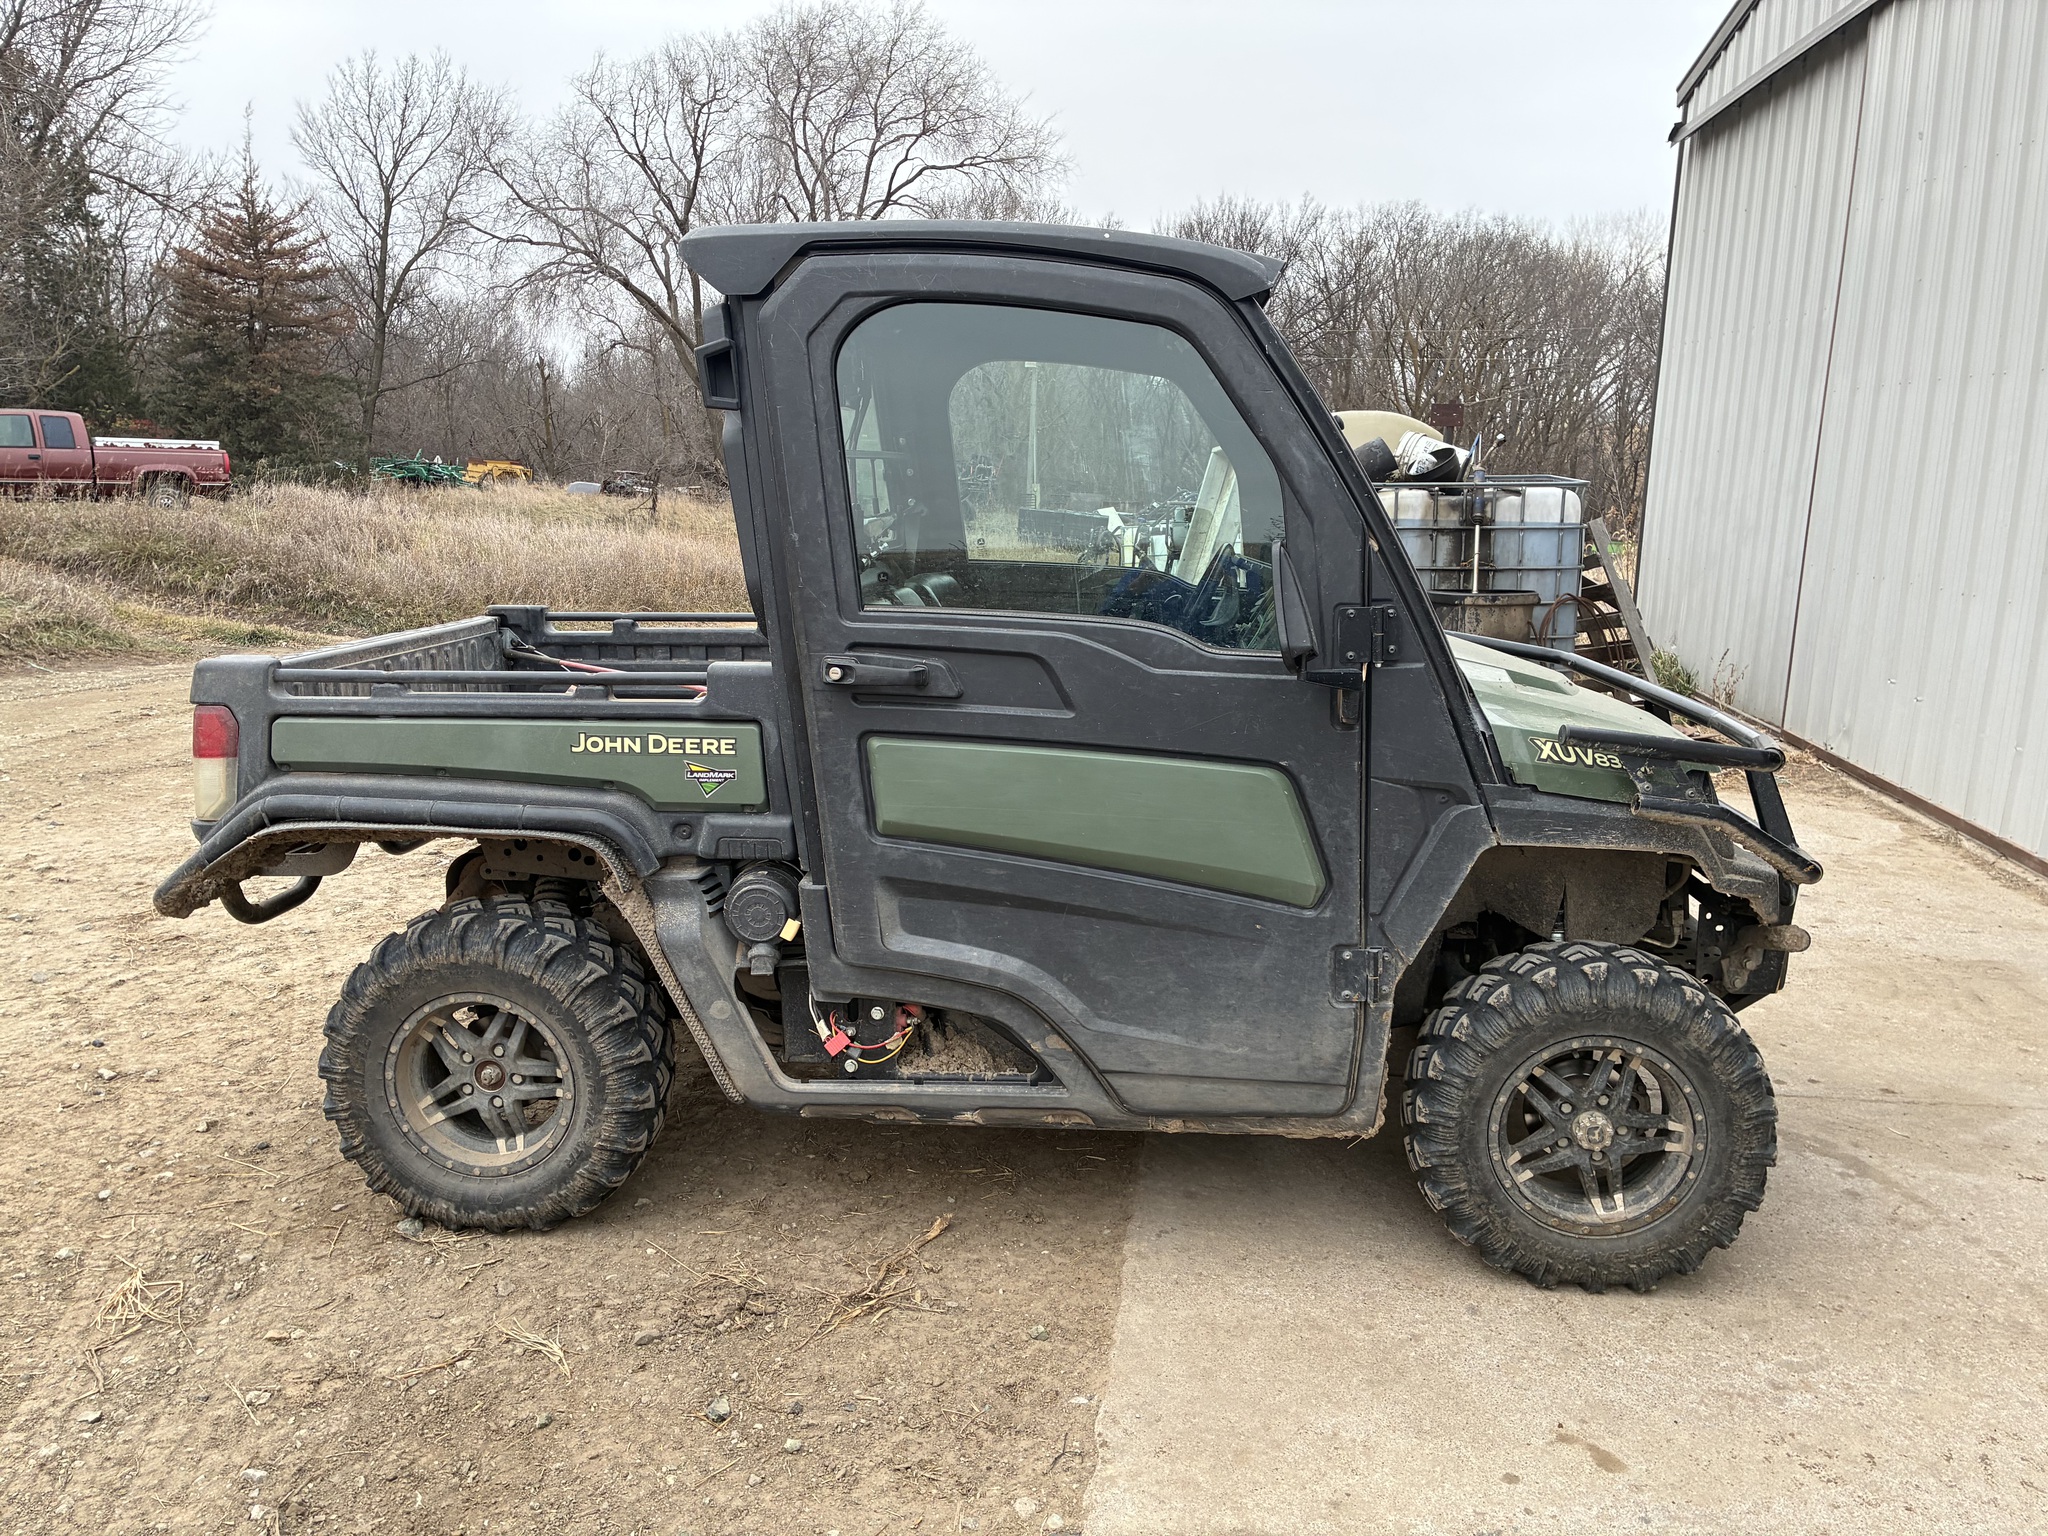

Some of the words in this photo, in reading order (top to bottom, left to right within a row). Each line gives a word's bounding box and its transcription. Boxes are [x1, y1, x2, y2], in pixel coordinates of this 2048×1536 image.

[571, 732, 642, 753] JOHN
[647, 733, 737, 755] DEERE
[1533, 738, 1626, 769] XUV83
